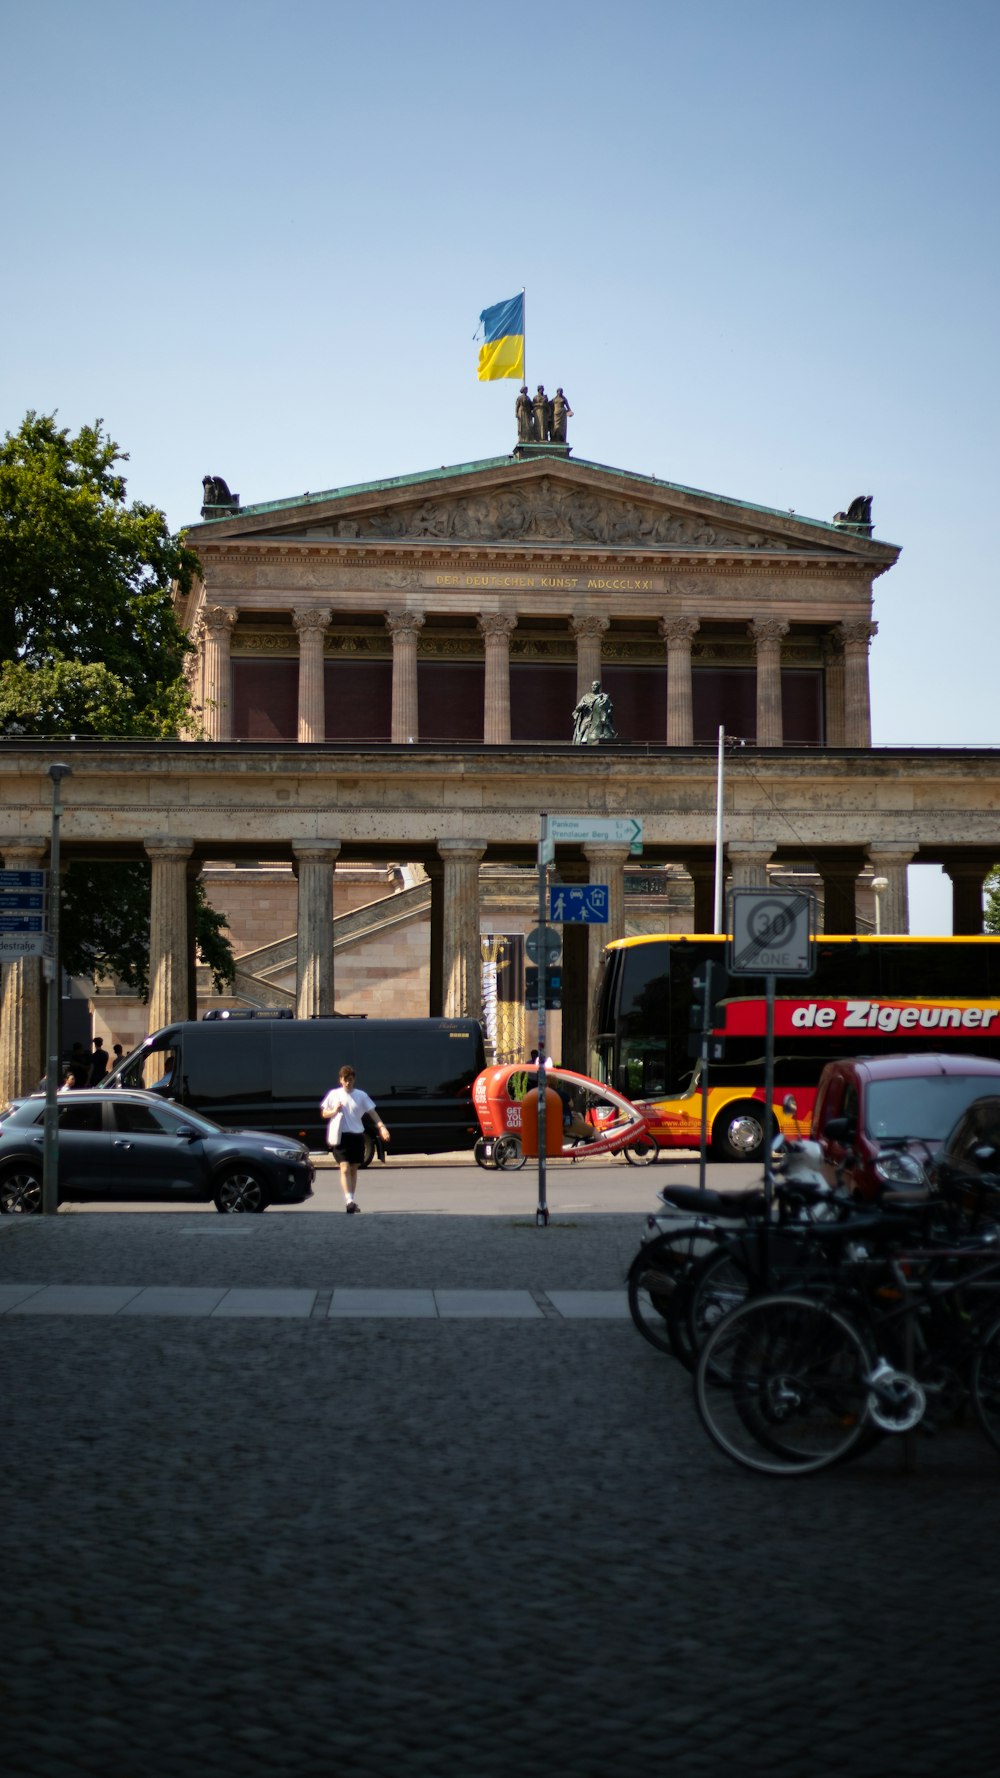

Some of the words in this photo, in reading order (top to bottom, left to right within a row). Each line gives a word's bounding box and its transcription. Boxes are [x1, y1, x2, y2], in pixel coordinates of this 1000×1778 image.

[436, 575, 459, 585] DER
[466, 576, 535, 587] DEUTSCHEN
[541, 578, 578, 588] KUNST
[588, 579, 653, 590] MDCCCLXXI
[552, 820, 579, 828] Pankow
[552, 830, 589, 838] Prenzlauer
[592, 831, 609, 840] Berg
[757, 912, 788, 935] 30
[751, 952, 790, 966] ZONE
[791, 1003, 836, 1028] de
[843, 1001, 999, 1032] Zigeuner
